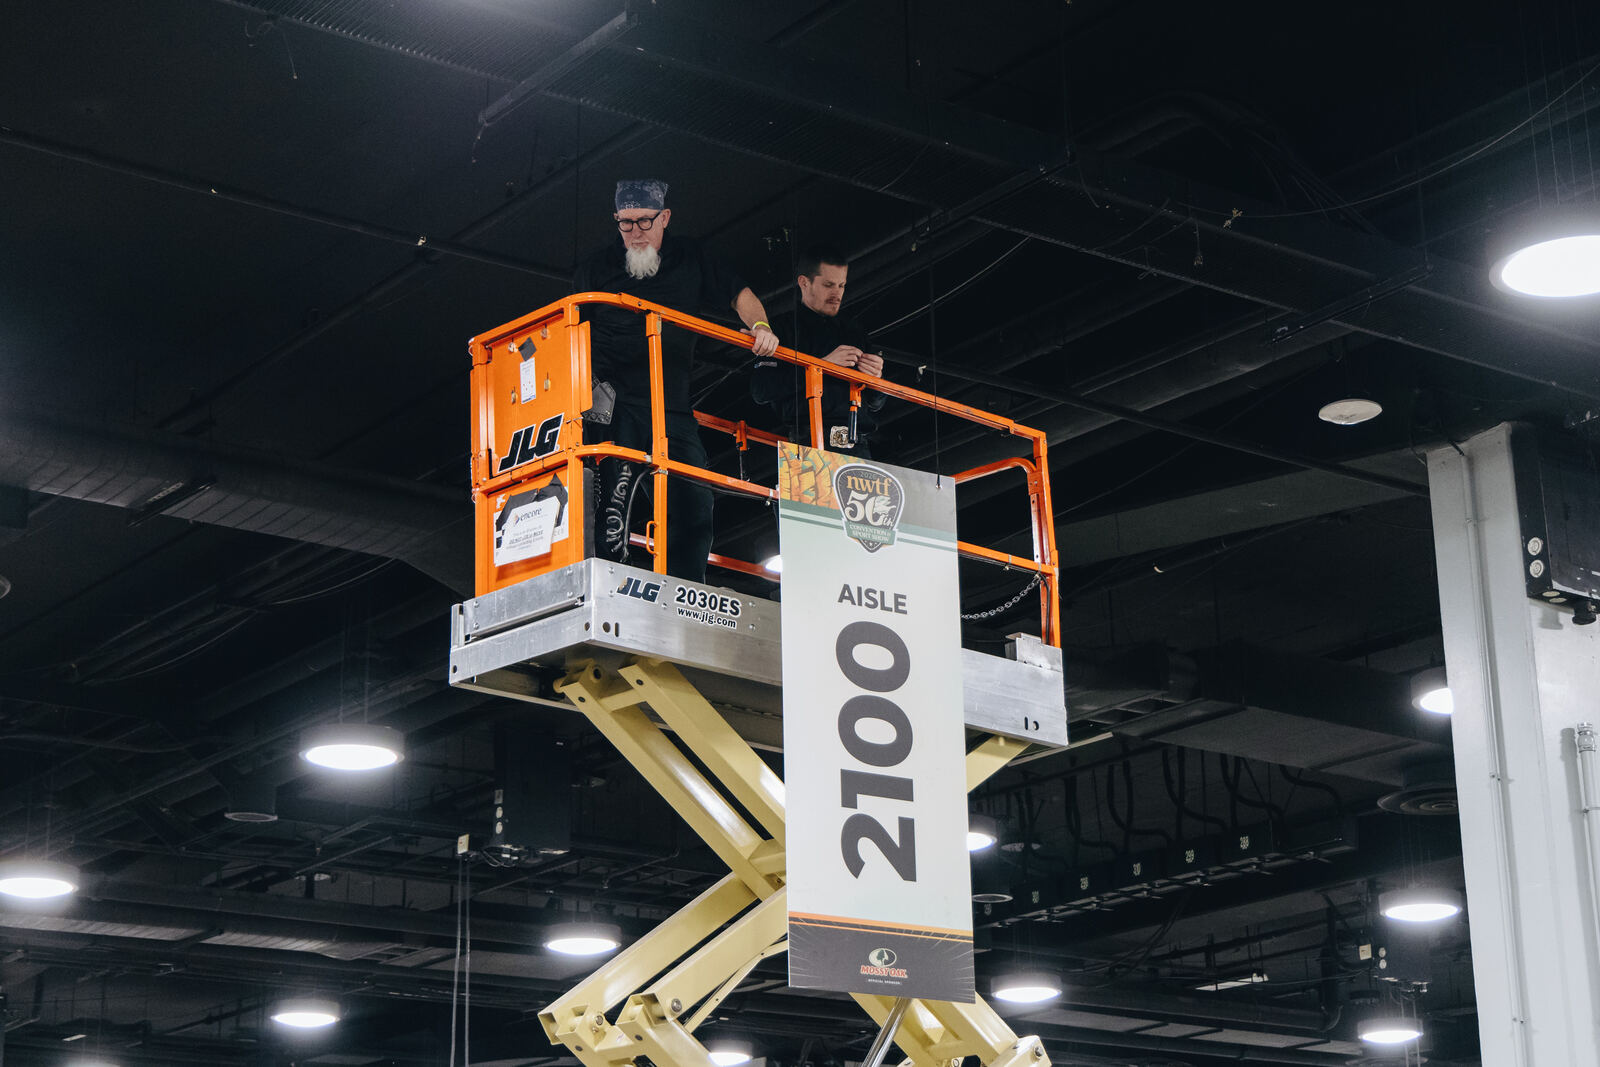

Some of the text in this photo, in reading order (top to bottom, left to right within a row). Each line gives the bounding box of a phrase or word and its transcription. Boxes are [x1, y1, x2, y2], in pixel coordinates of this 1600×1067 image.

[498, 413, 564, 472] JLG
[847, 475, 892, 496] nwtf
[617, 577, 660, 602] JLG
[676, 587, 740, 616] 2030ES
[838, 584, 908, 615] AISLE
[677, 608, 736, 628] www.jlg.com
[835, 621, 917, 882] 2100
[861, 965, 907, 978] MOSSY OAK
